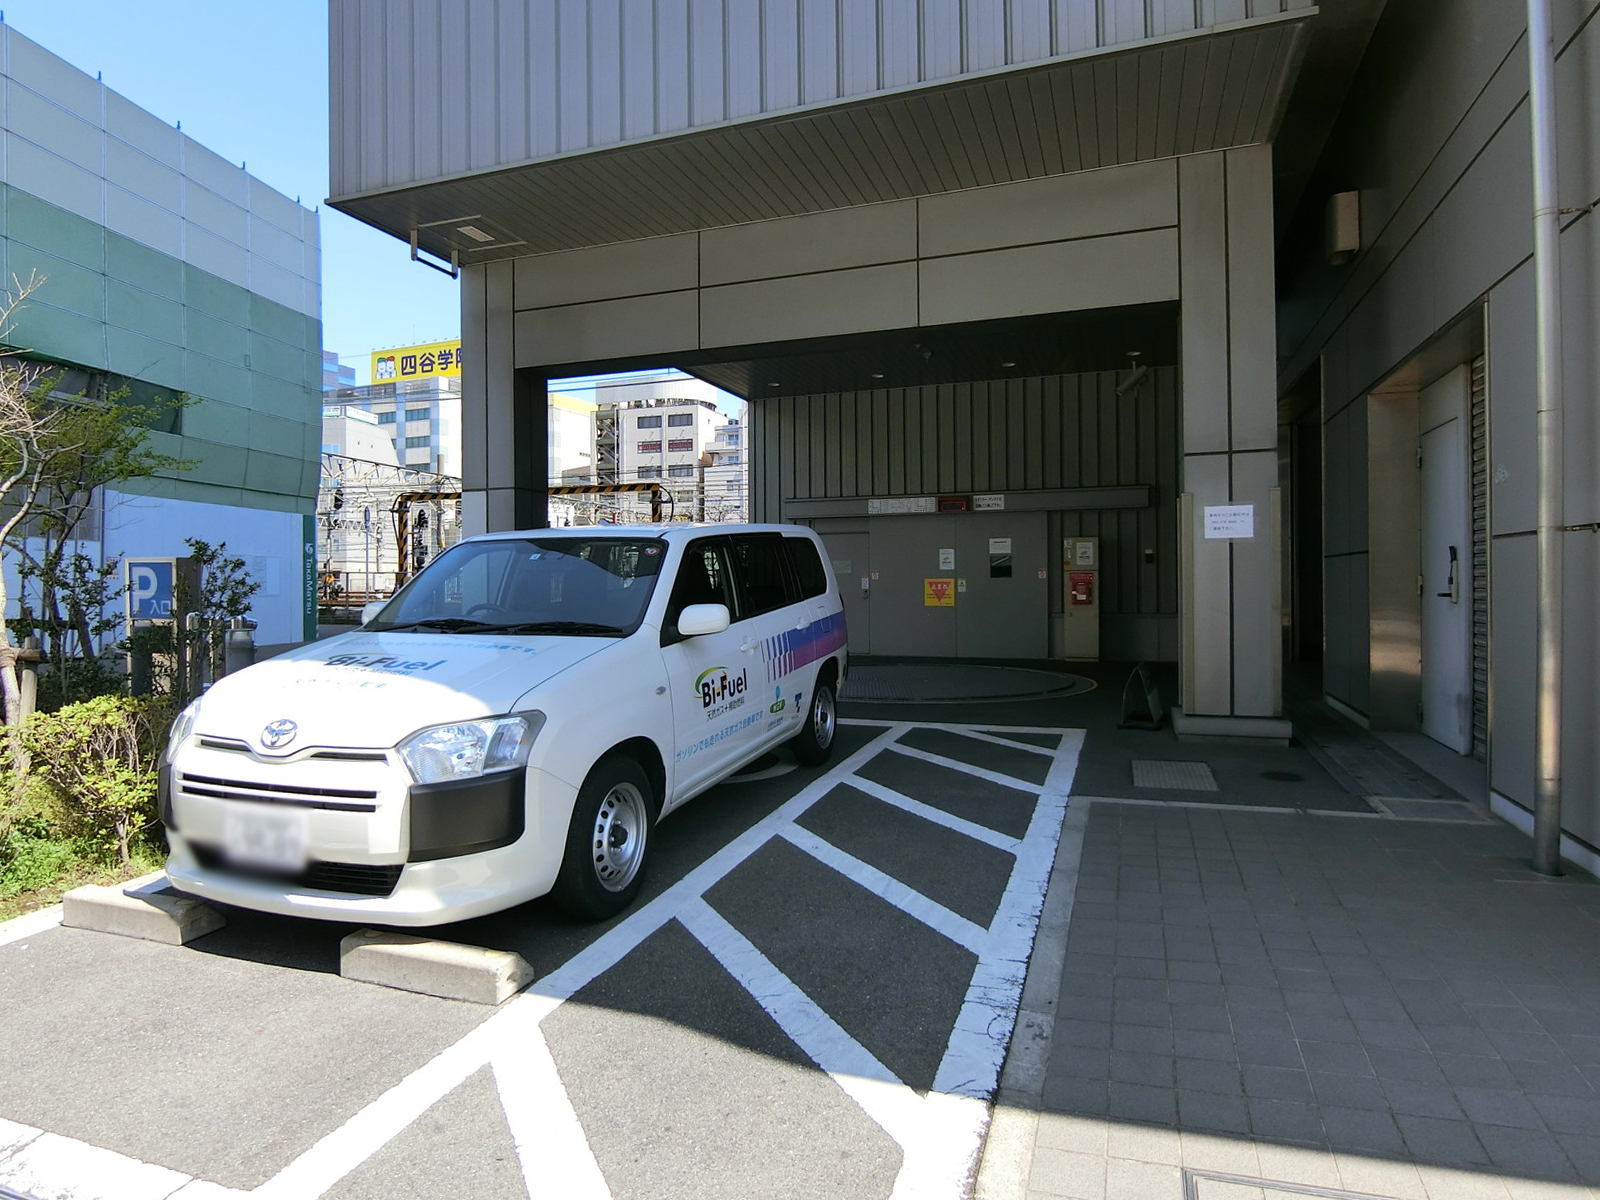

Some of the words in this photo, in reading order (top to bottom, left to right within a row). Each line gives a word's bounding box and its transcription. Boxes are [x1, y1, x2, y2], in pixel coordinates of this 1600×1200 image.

[132, 566, 158, 615] P
[151, 601, 171, 615] 入口
[324, 656, 448, 671] Bi-Fuel
[701, 667, 748, 708] Bi-Fuel
